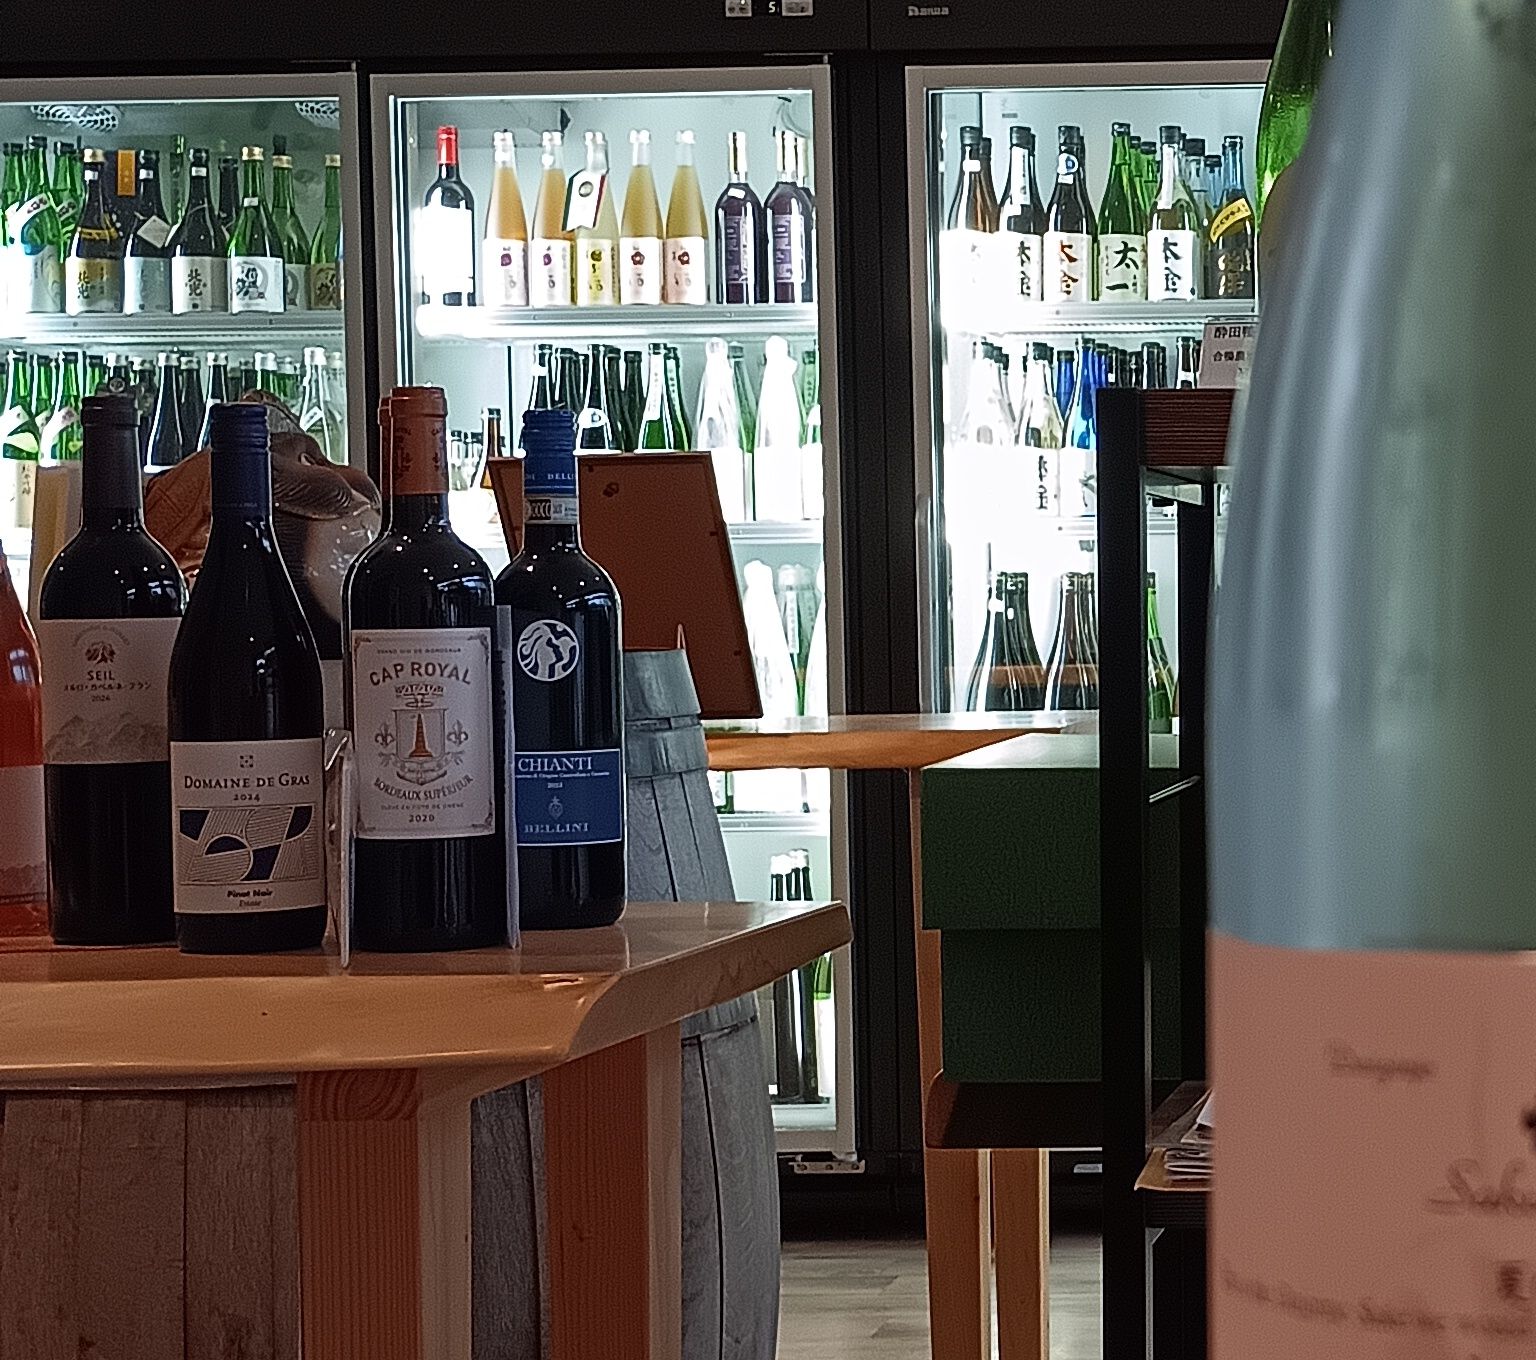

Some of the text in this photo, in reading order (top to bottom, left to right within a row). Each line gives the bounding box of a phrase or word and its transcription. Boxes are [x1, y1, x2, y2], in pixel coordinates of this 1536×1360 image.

[87, 670, 115, 681] SEIL
[370, 662, 471, 686] CAP ROYAL
[518, 757, 592, 772] CHIANTI
[184, 773, 310, 789] DOMAINE DE GRAS
[374, 778, 421, 800] BORDEAUX
[409, 814, 435, 823] 2020
[524, 823, 588, 833] BELLINI
